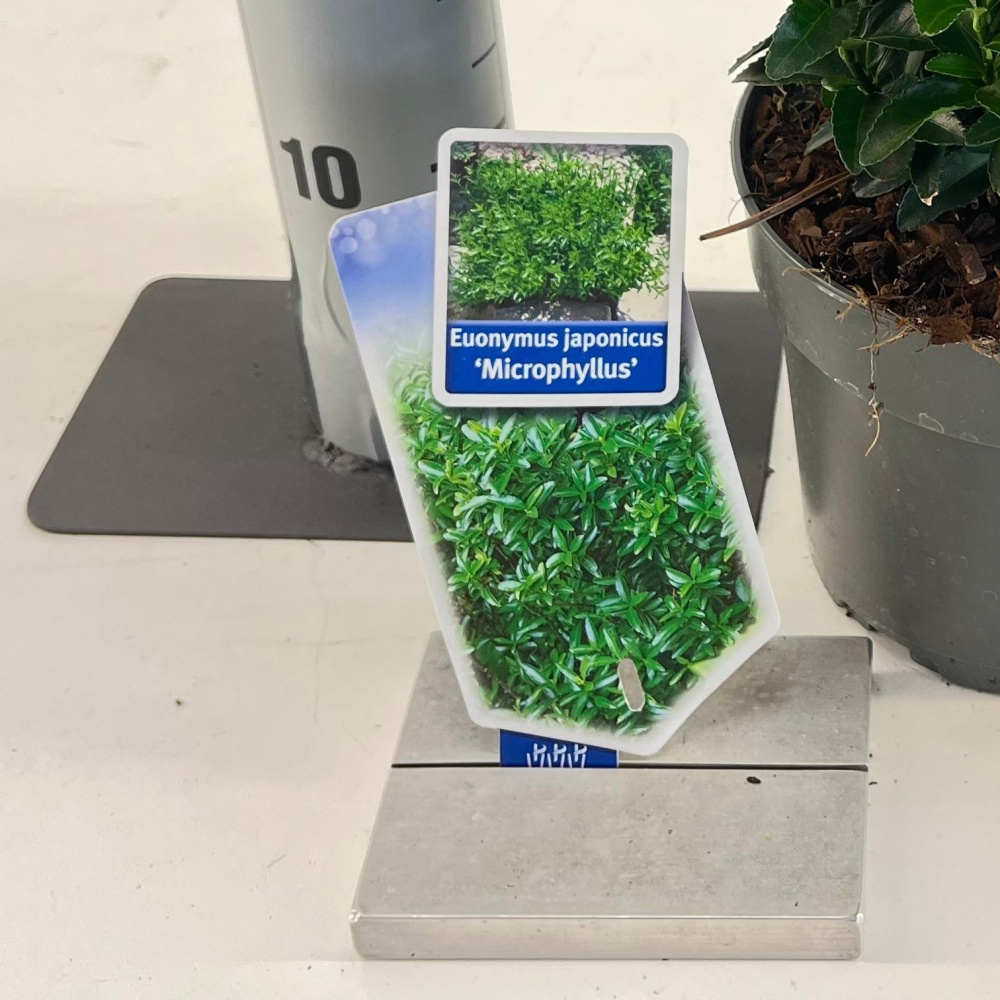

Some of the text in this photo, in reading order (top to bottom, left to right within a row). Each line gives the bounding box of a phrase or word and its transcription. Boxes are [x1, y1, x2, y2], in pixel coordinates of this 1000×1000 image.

[279, 136, 362, 210] 10
[450, 327, 664, 352] Euonymus japonicus
